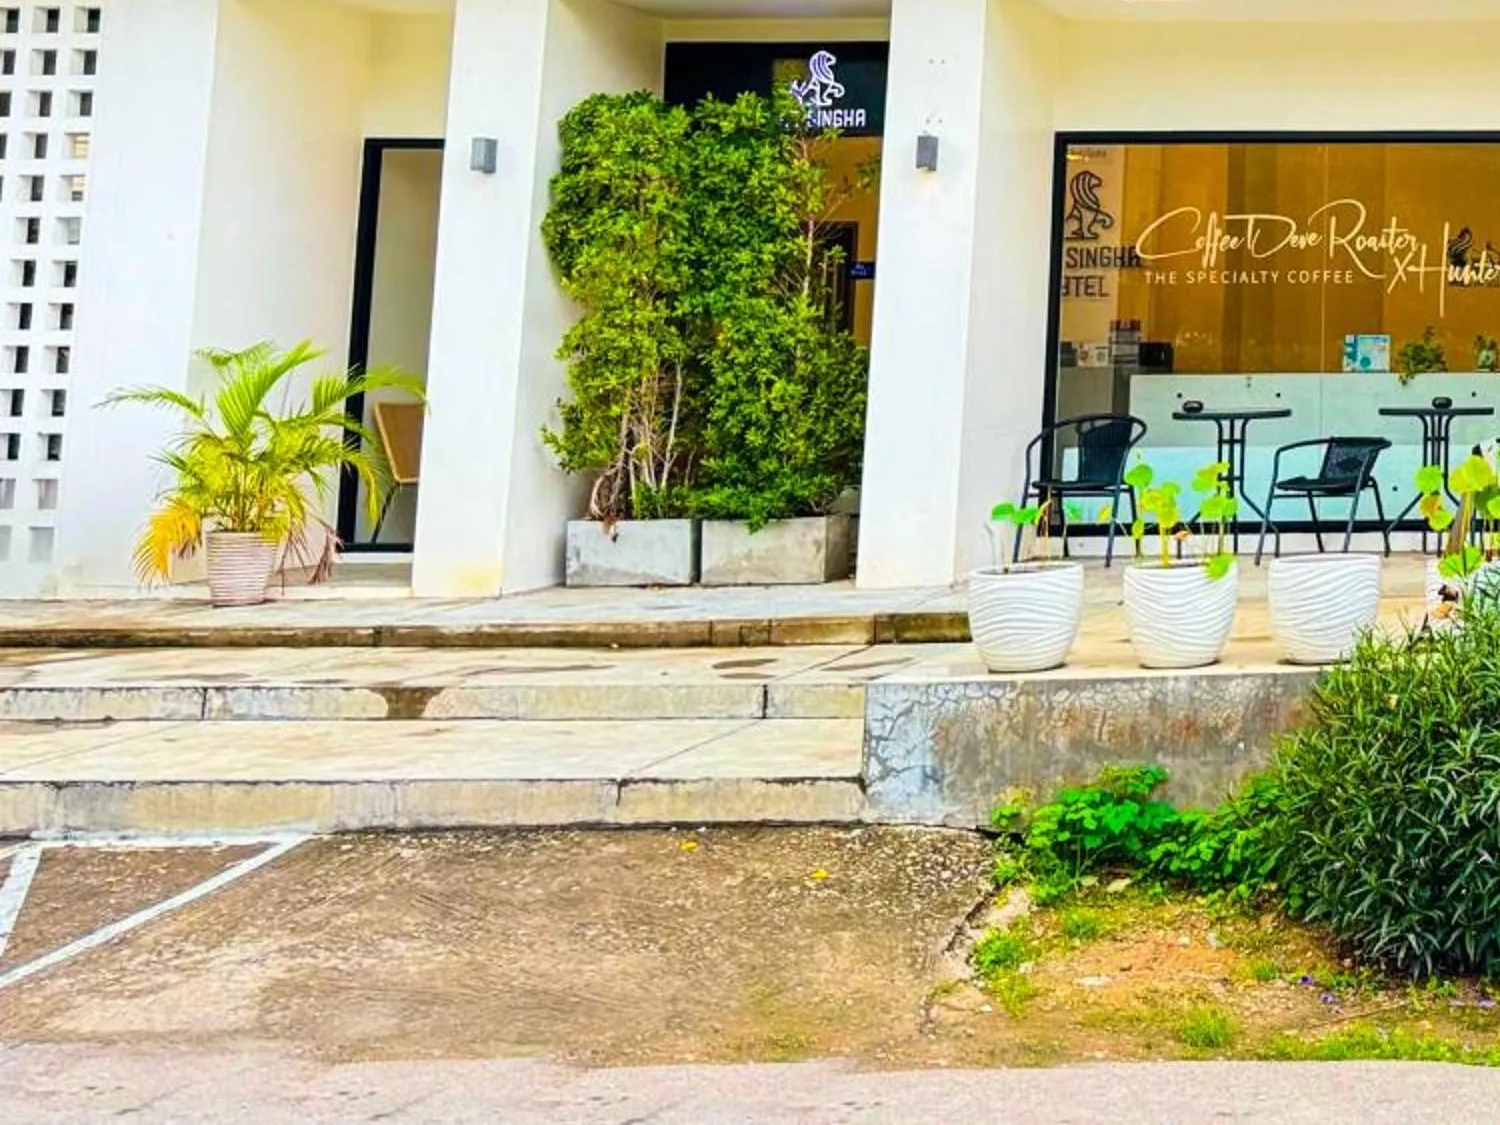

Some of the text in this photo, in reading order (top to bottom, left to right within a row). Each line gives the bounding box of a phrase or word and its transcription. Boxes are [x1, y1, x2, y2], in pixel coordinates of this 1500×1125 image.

[1135, 206, 1245, 269] Coffee
[1145, 270, 1354, 284] THE SPECIALTY COFFEE
